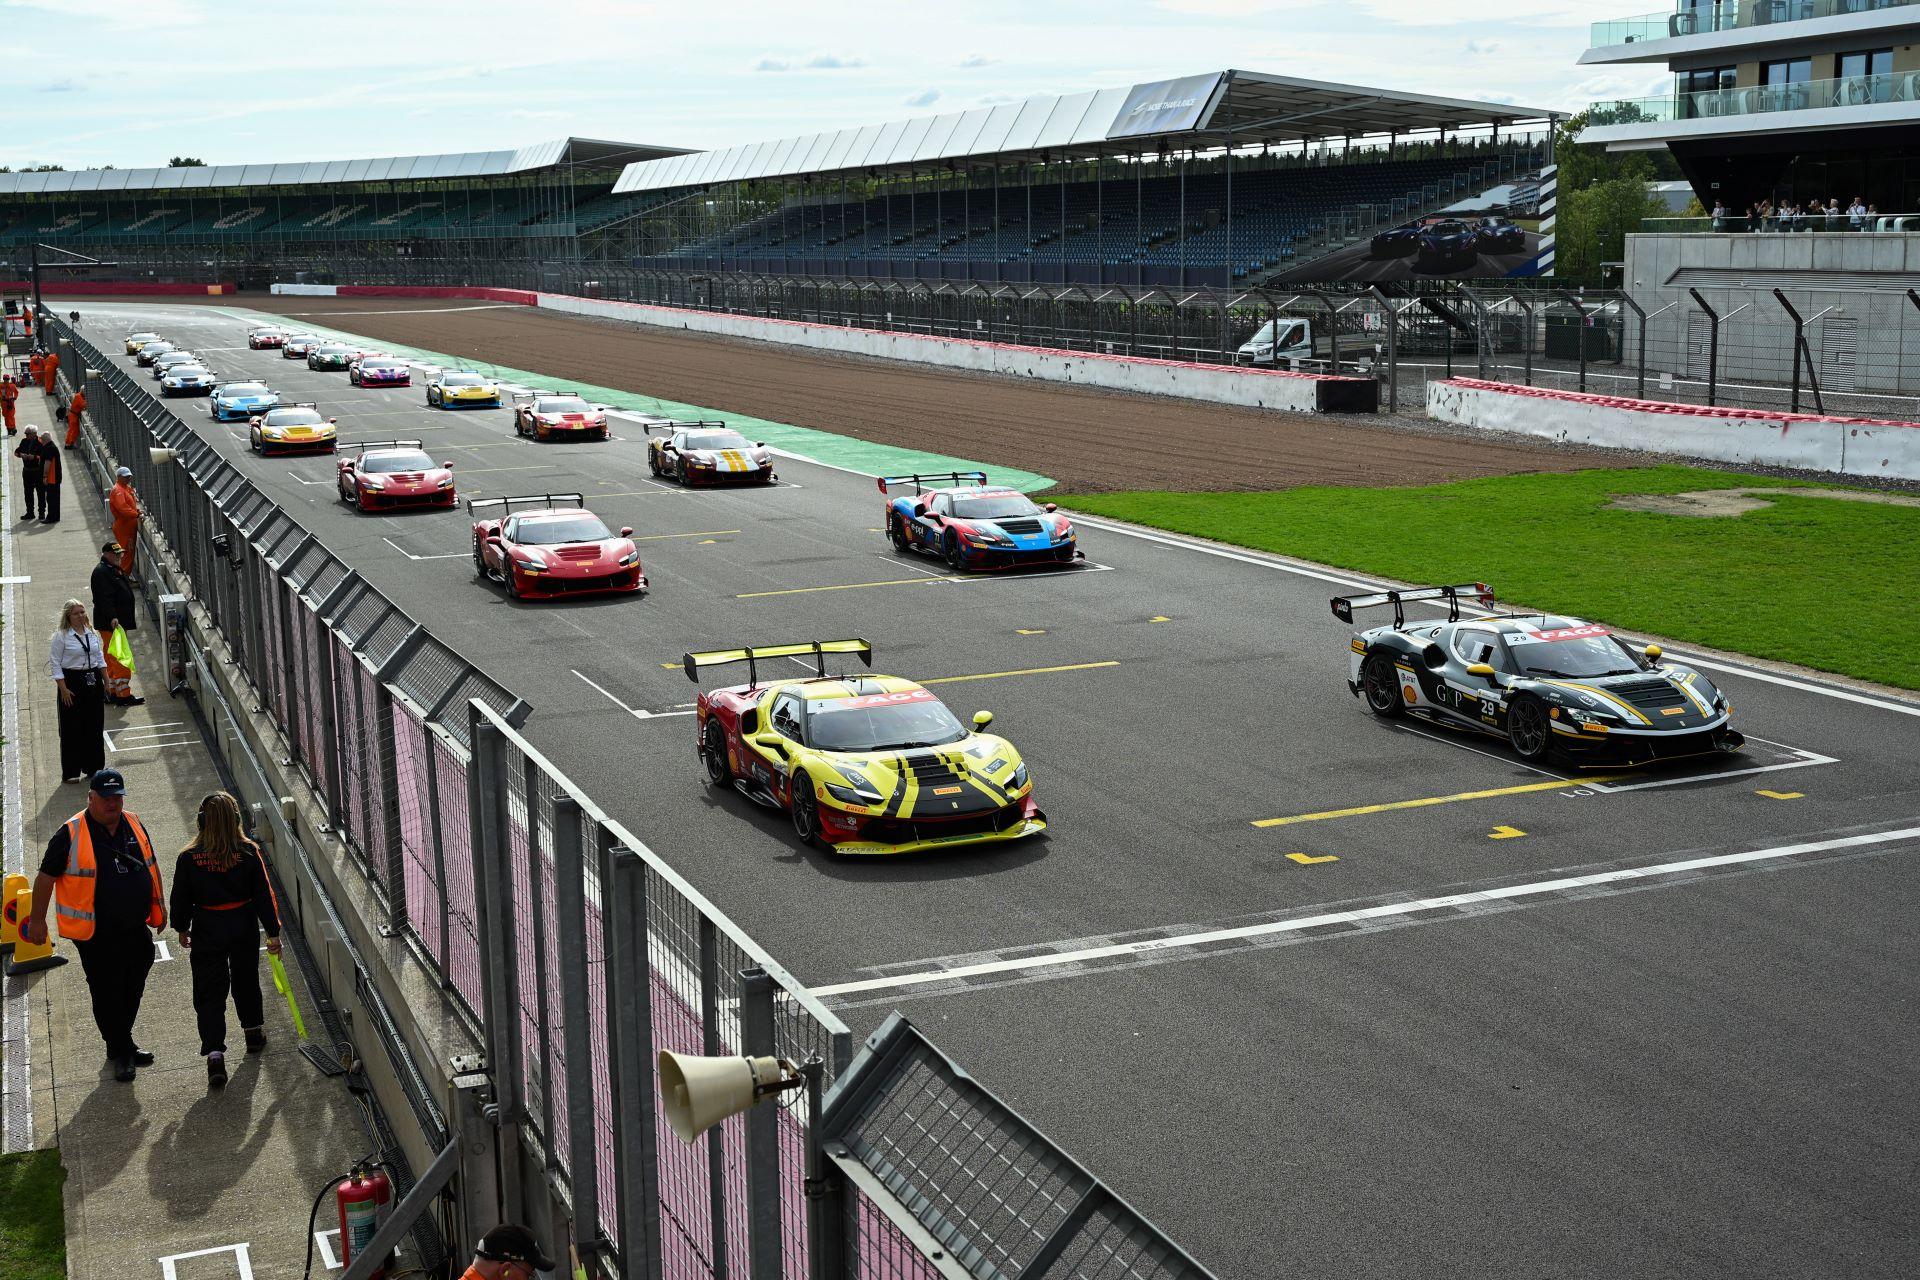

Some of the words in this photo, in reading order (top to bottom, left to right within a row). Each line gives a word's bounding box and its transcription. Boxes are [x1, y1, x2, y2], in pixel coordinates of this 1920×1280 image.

[1540, 626, 1606, 639] FAGE
[1436, 684, 1462, 708] GKP
[1481, 699, 1494, 716] 29
[935, 787, 961, 795] PIRELLI
[845, 804, 868, 814] PIRELLI
